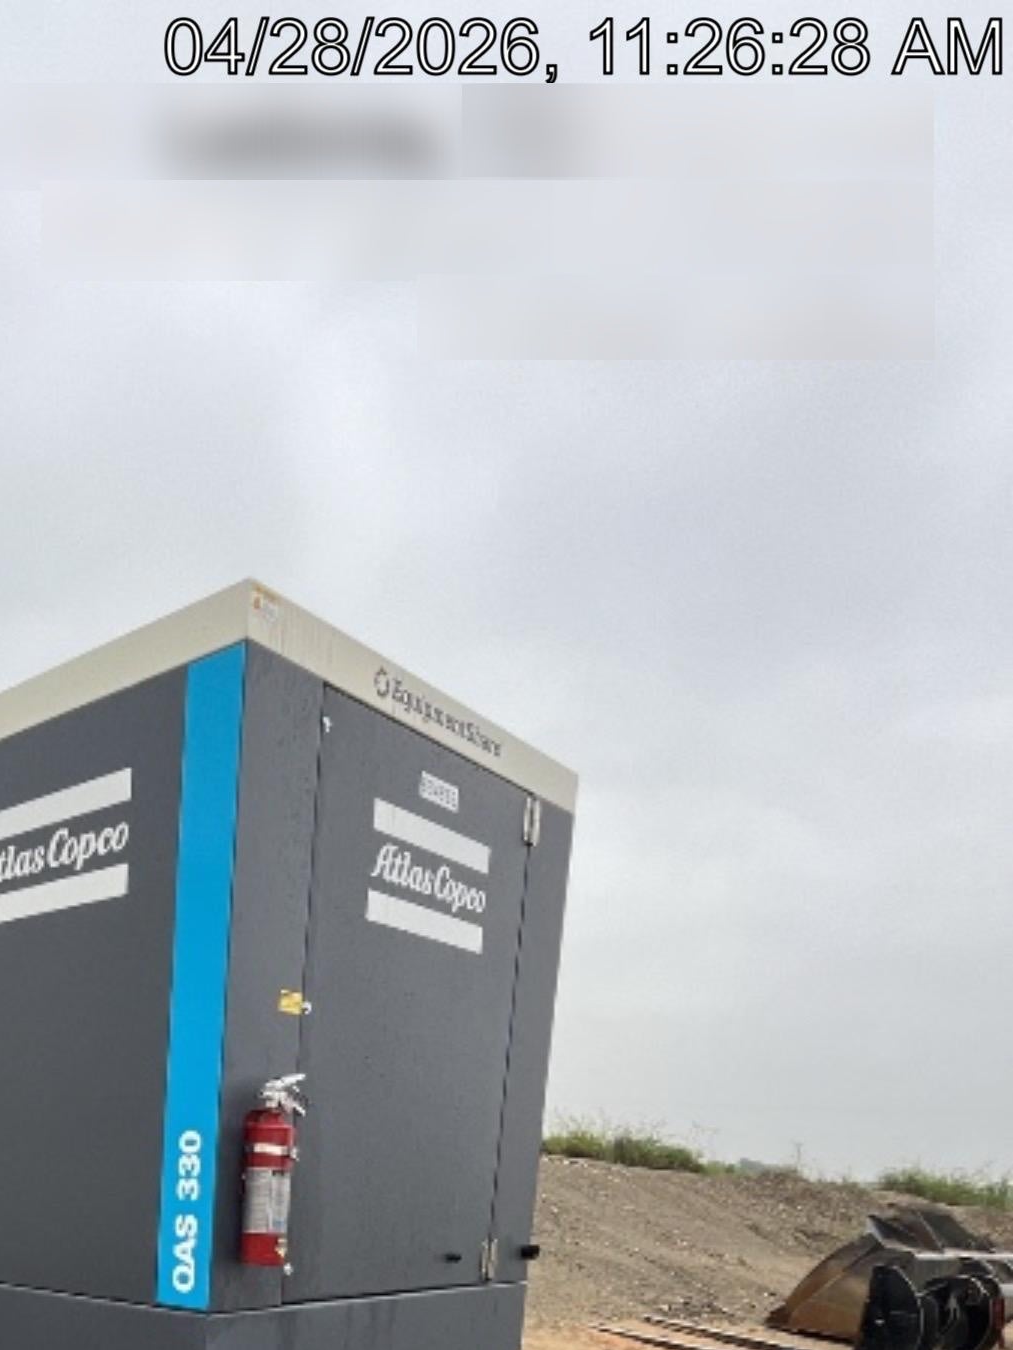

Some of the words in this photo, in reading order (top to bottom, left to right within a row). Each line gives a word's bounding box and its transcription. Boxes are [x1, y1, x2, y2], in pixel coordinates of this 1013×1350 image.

[47, 822, 130, 871] Copco
[371, 843, 433, 895] Atlas
[433, 865, 486, 913] Copco
[176, 1130, 201, 1201] 330
[172, 1214, 198, 1293] QAS
